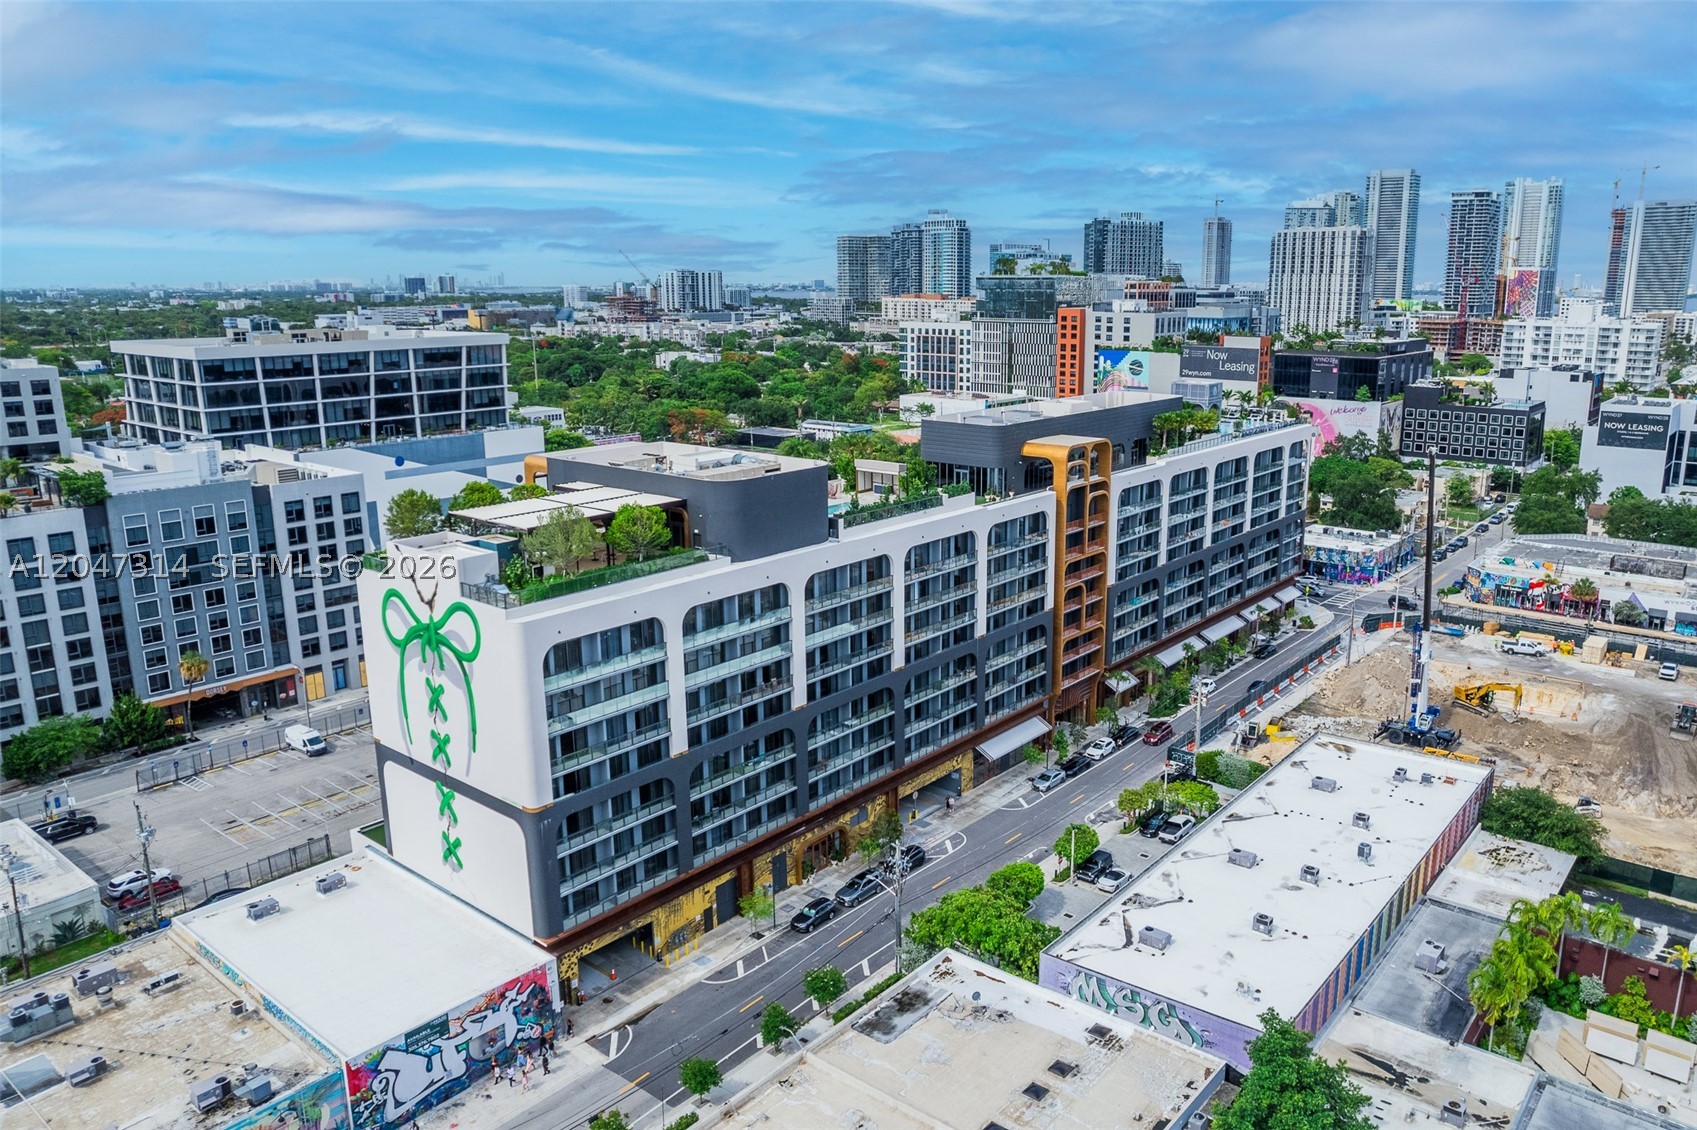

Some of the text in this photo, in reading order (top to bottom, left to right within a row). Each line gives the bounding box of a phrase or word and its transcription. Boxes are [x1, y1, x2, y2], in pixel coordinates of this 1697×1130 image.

[1206, 349, 1228, 360] Now
[1181, 368, 1212, 377] 29wyn.com
[1219, 360, 1255, 375] Leasing
[1628, 423, 1664, 432] LEASING
